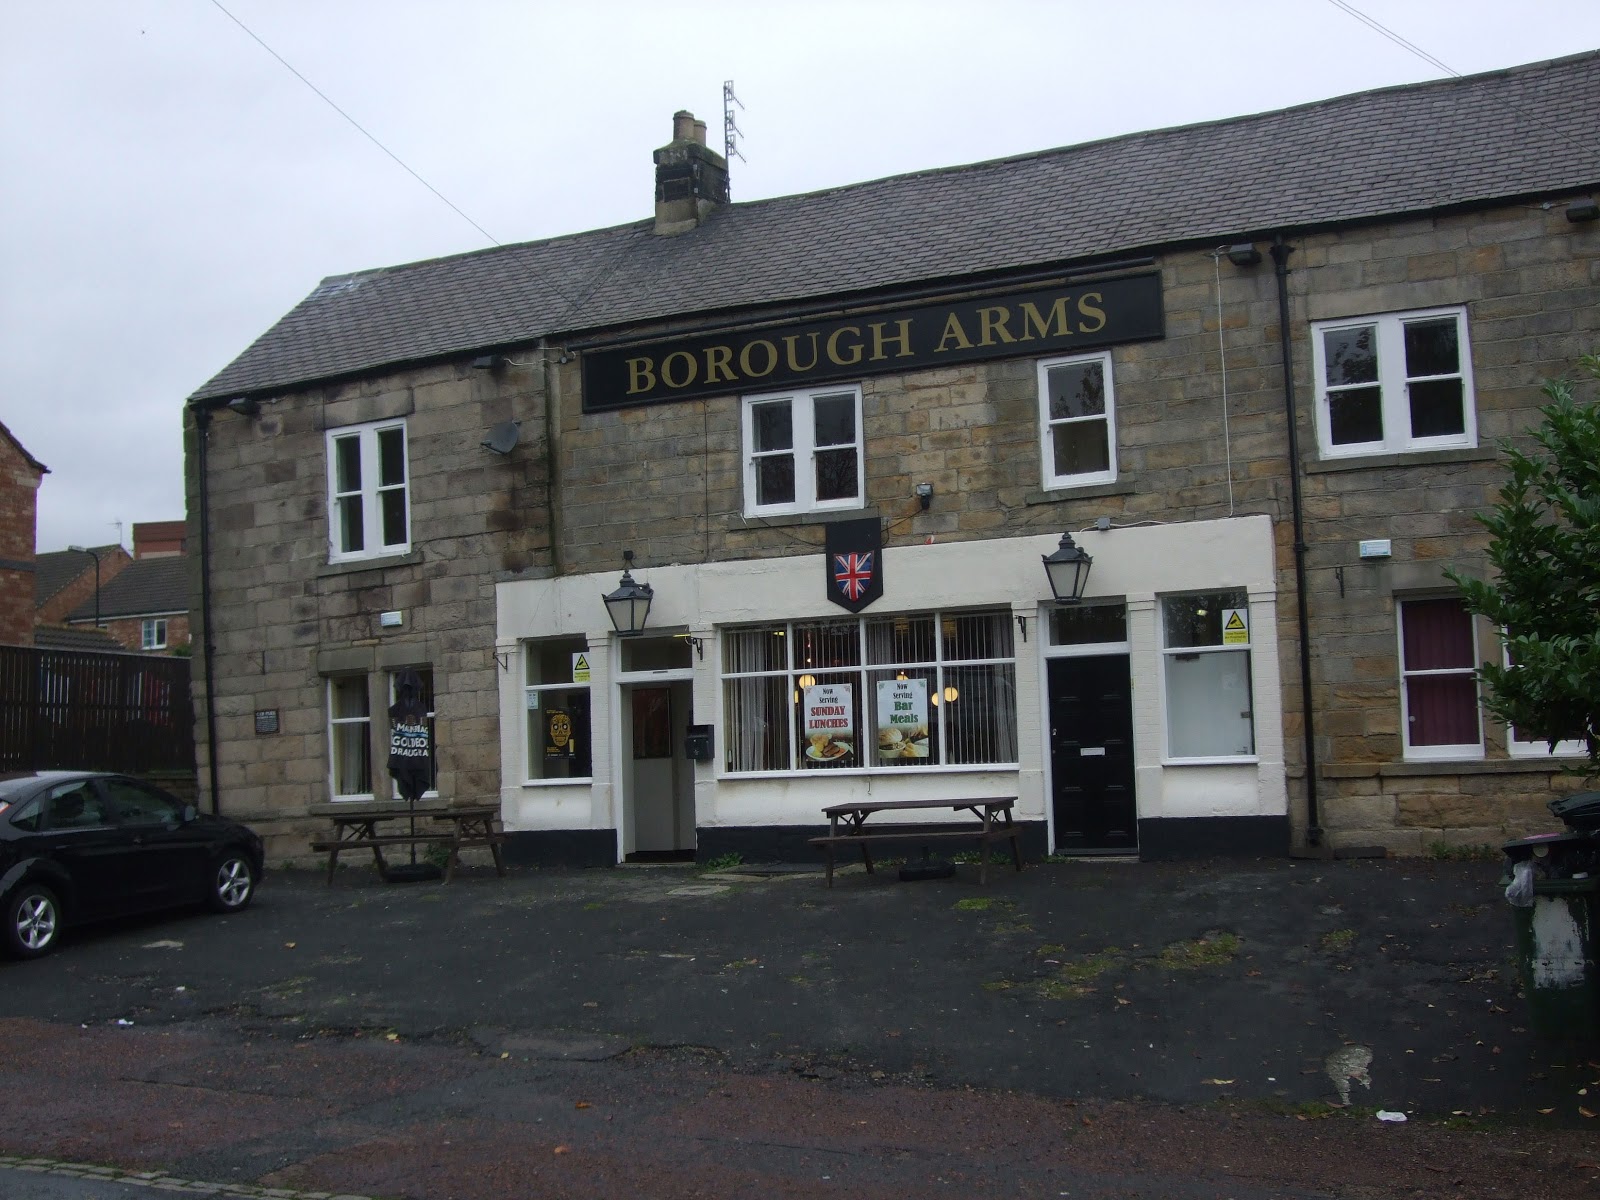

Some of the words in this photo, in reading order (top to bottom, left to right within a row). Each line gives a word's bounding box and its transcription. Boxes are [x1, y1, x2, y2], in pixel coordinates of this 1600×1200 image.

[625, 319, 914, 395] BOROUGH
[934, 292, 1107, 353] ARMS
[811, 706, 845, 716] SUNDAY
[893, 701, 913, 711] Bar
[809, 718, 848, 728] LUNCHES
[890, 713, 919, 724] Meals
